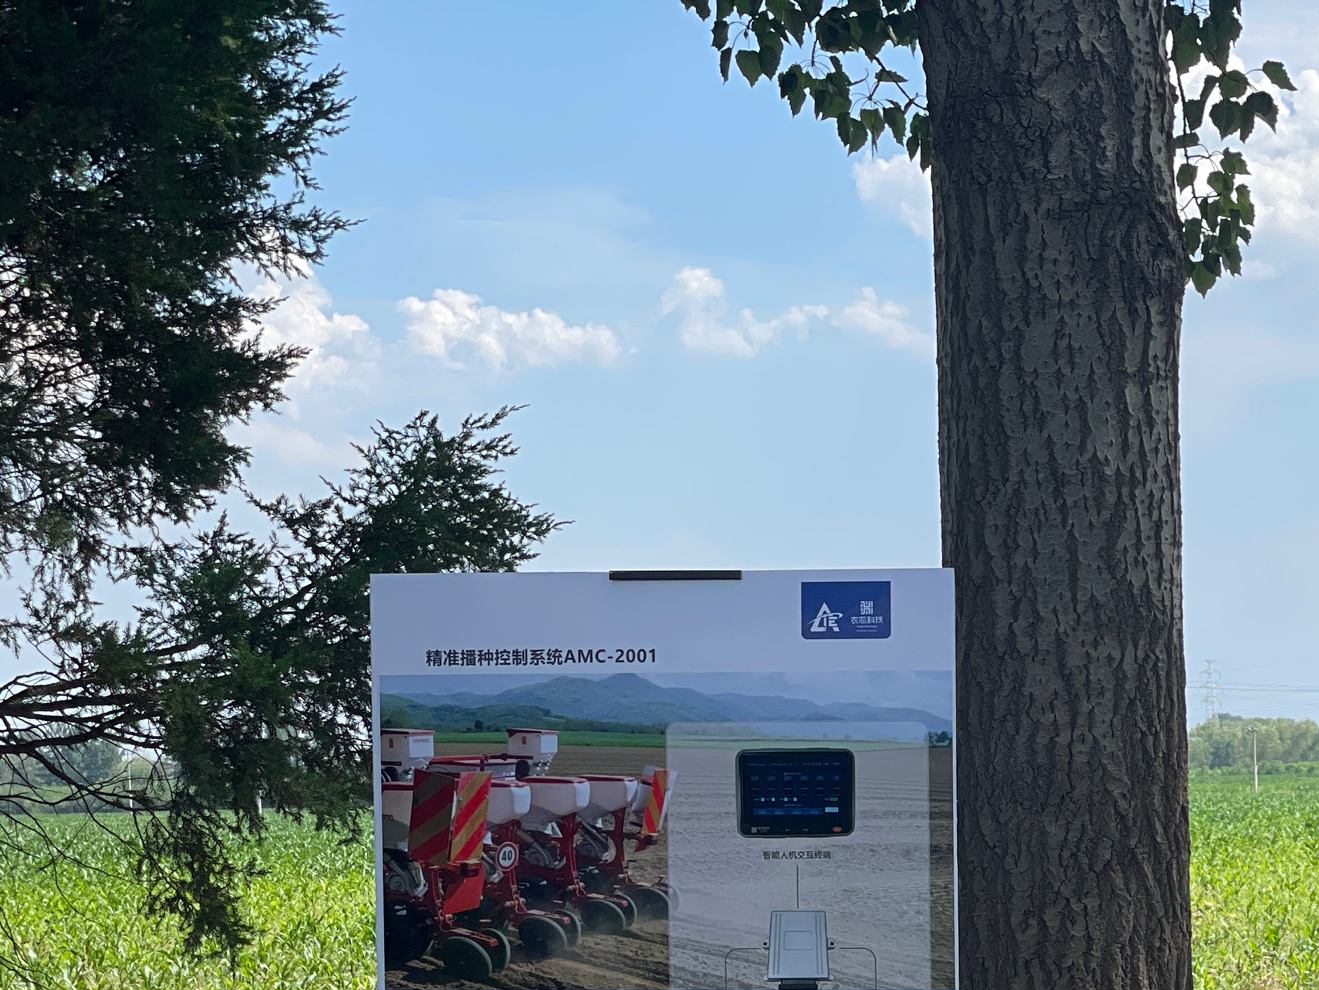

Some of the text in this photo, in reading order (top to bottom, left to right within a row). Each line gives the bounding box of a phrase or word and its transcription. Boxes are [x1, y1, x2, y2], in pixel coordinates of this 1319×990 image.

[425, 648, 657, 667] 精准播种控制系统AMC-2001
[499, 849, 514, 862] 40
[762, 850, 832, 860] 智能人机交互终端
